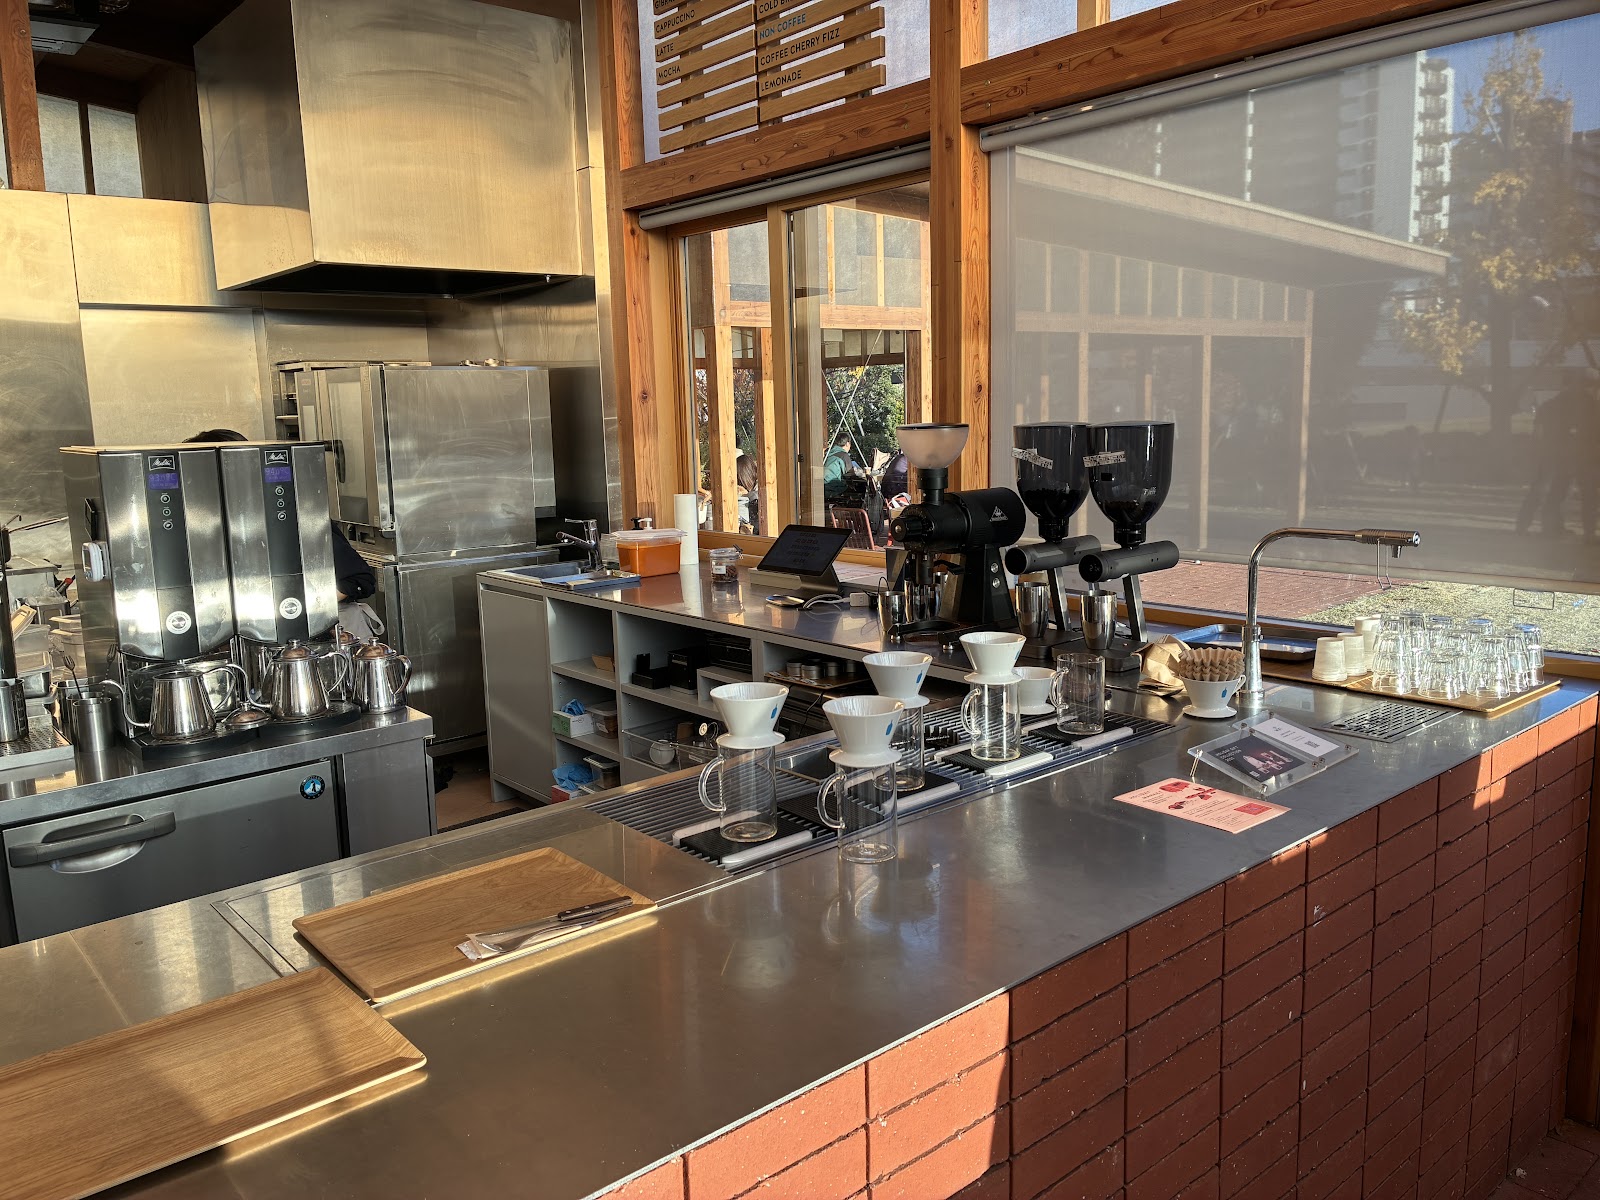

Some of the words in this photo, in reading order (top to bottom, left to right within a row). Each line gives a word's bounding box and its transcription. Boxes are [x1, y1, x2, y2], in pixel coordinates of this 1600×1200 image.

[758, 0, 779, 14] COLD
[655, 9, 696, 33] CAPPUCCINO
[760, 26, 775, 39] NON
[777, 13, 807, 33] COFFEE
[656, 42, 674, 57] LATTE
[760, 47, 789, 66] COFFEE
[790, 34, 820, 55] CHERRY
[822, 27, 840, 43] FIZZ
[658, 65, 681, 78] MOCHA
[761, 69, 802, 92] LEMONADE
